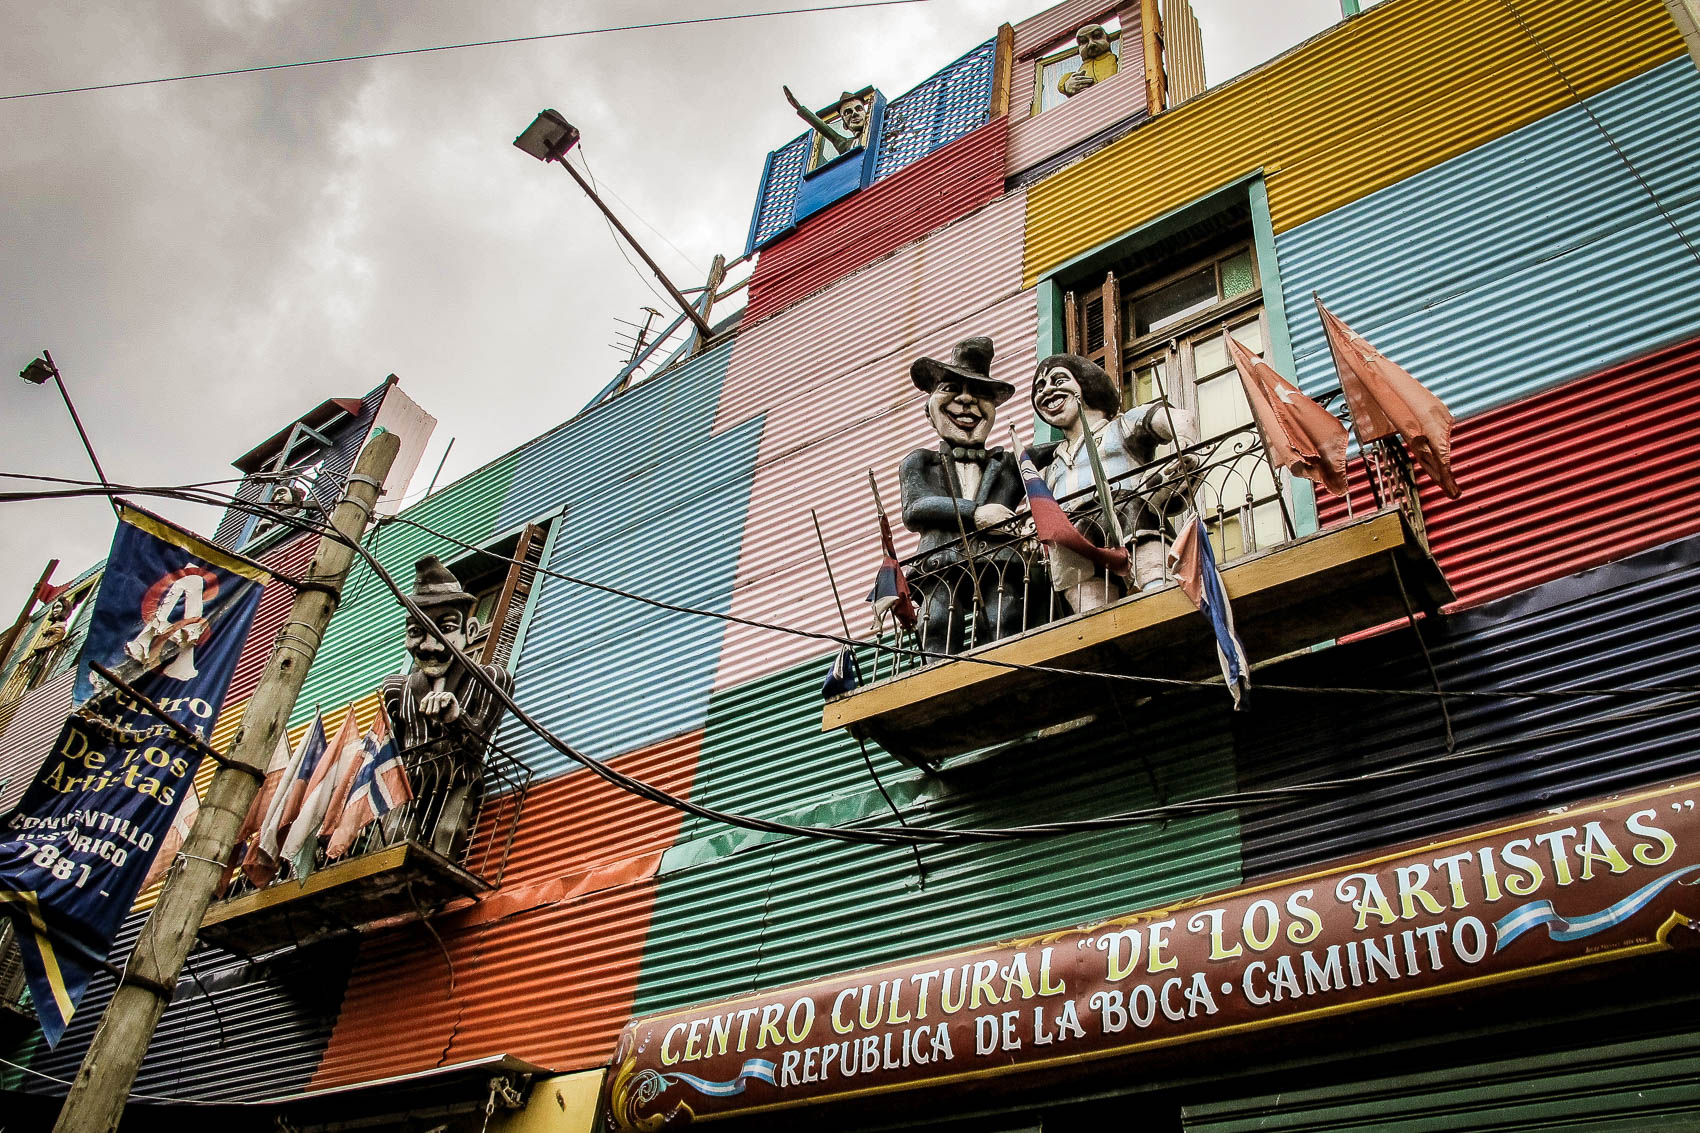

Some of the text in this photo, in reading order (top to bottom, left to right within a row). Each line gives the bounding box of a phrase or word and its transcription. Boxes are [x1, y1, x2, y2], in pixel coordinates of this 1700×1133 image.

[60, 727, 107, 770] De
[660, 996, 816, 1067] CENTRO
[831, 946, 1066, 1035] CULTURAL
[1187, 888, 1324, 961] LOS
[780, 1021, 955, 1088] REPUBLICA
[975, 1009, 1022, 1056] DE
[1033, 1000, 1087, 1045] LA
[1089, 971, 1219, 1034] BOCA
[1242, 915, 1488, 1006] CAMINITO
